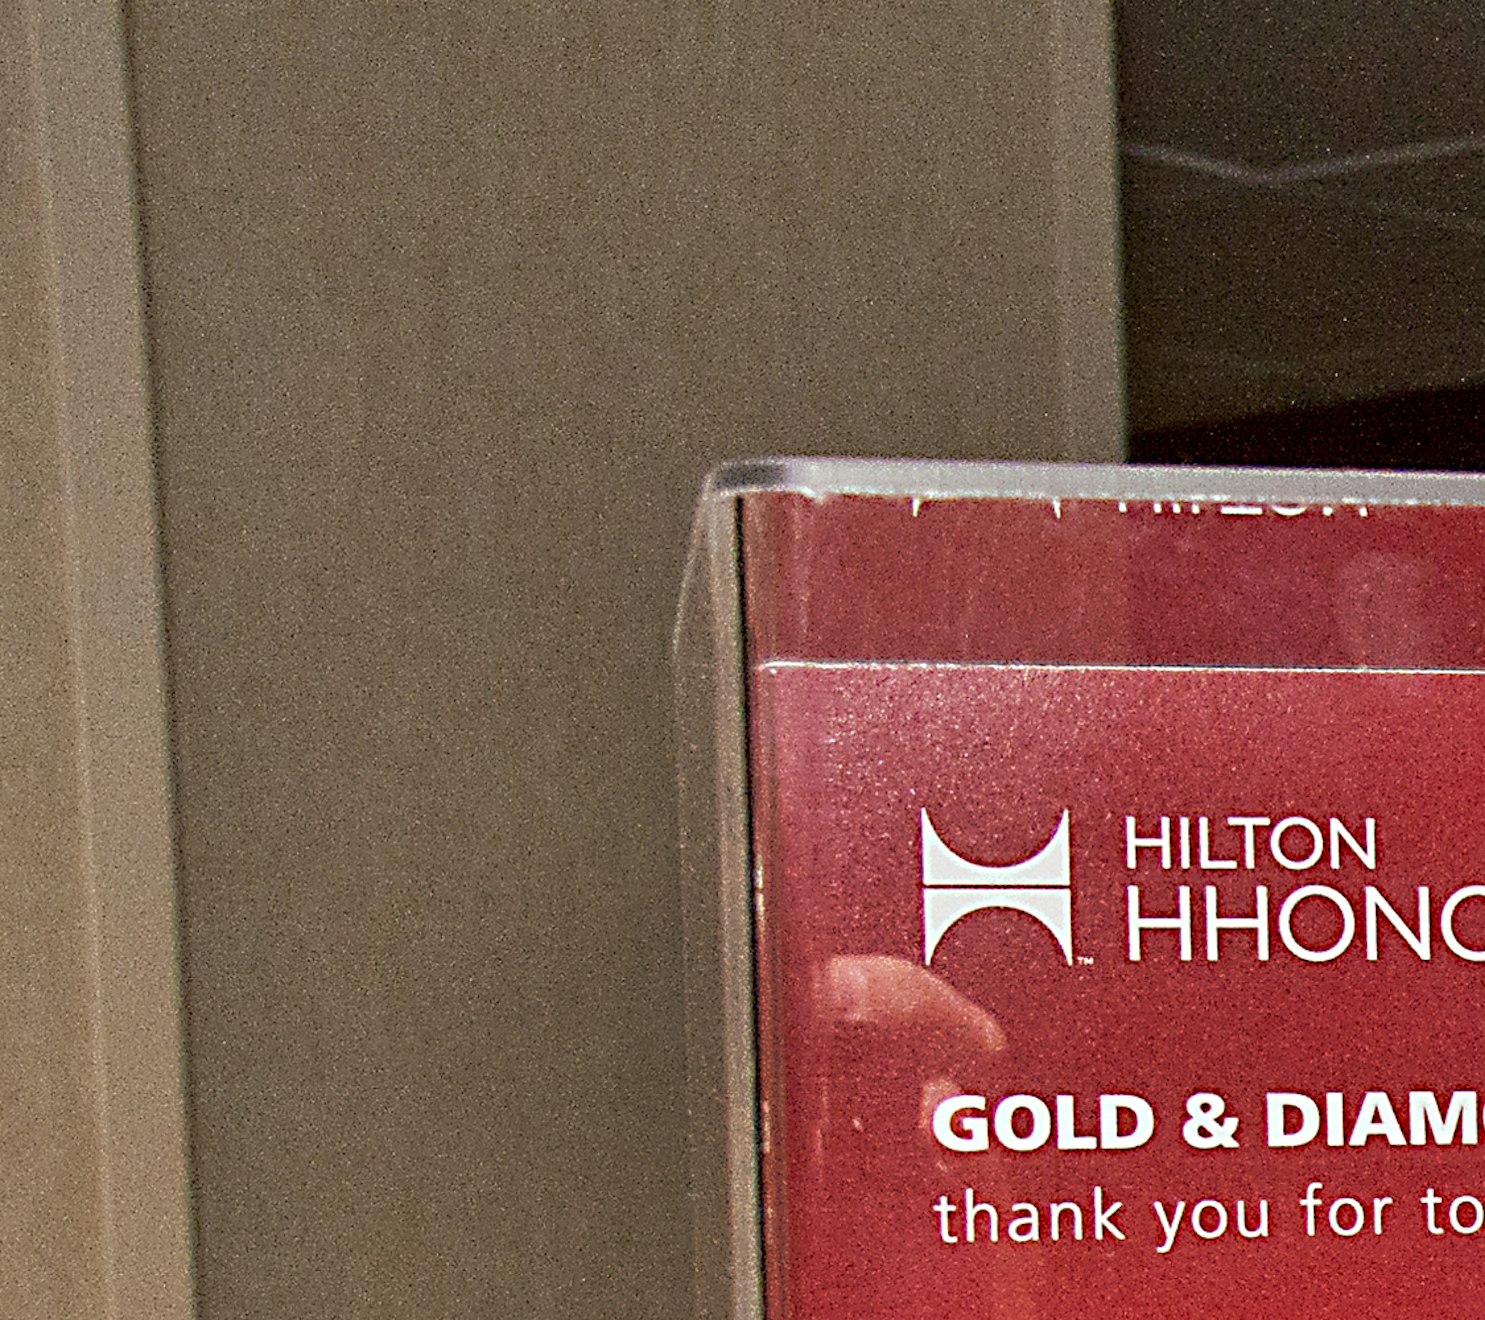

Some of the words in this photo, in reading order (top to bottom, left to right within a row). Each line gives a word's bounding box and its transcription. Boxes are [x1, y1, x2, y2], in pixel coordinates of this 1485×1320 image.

[1125, 816, 1378, 871] HILTON
[932, 1093, 1155, 1151] GOLD
[1182, 1093, 1240, 1149] &
[933, 1189, 1126, 1245] thank
[1156, 1192, 1271, 1252] you
[1300, 1182, 1395, 1237] for
